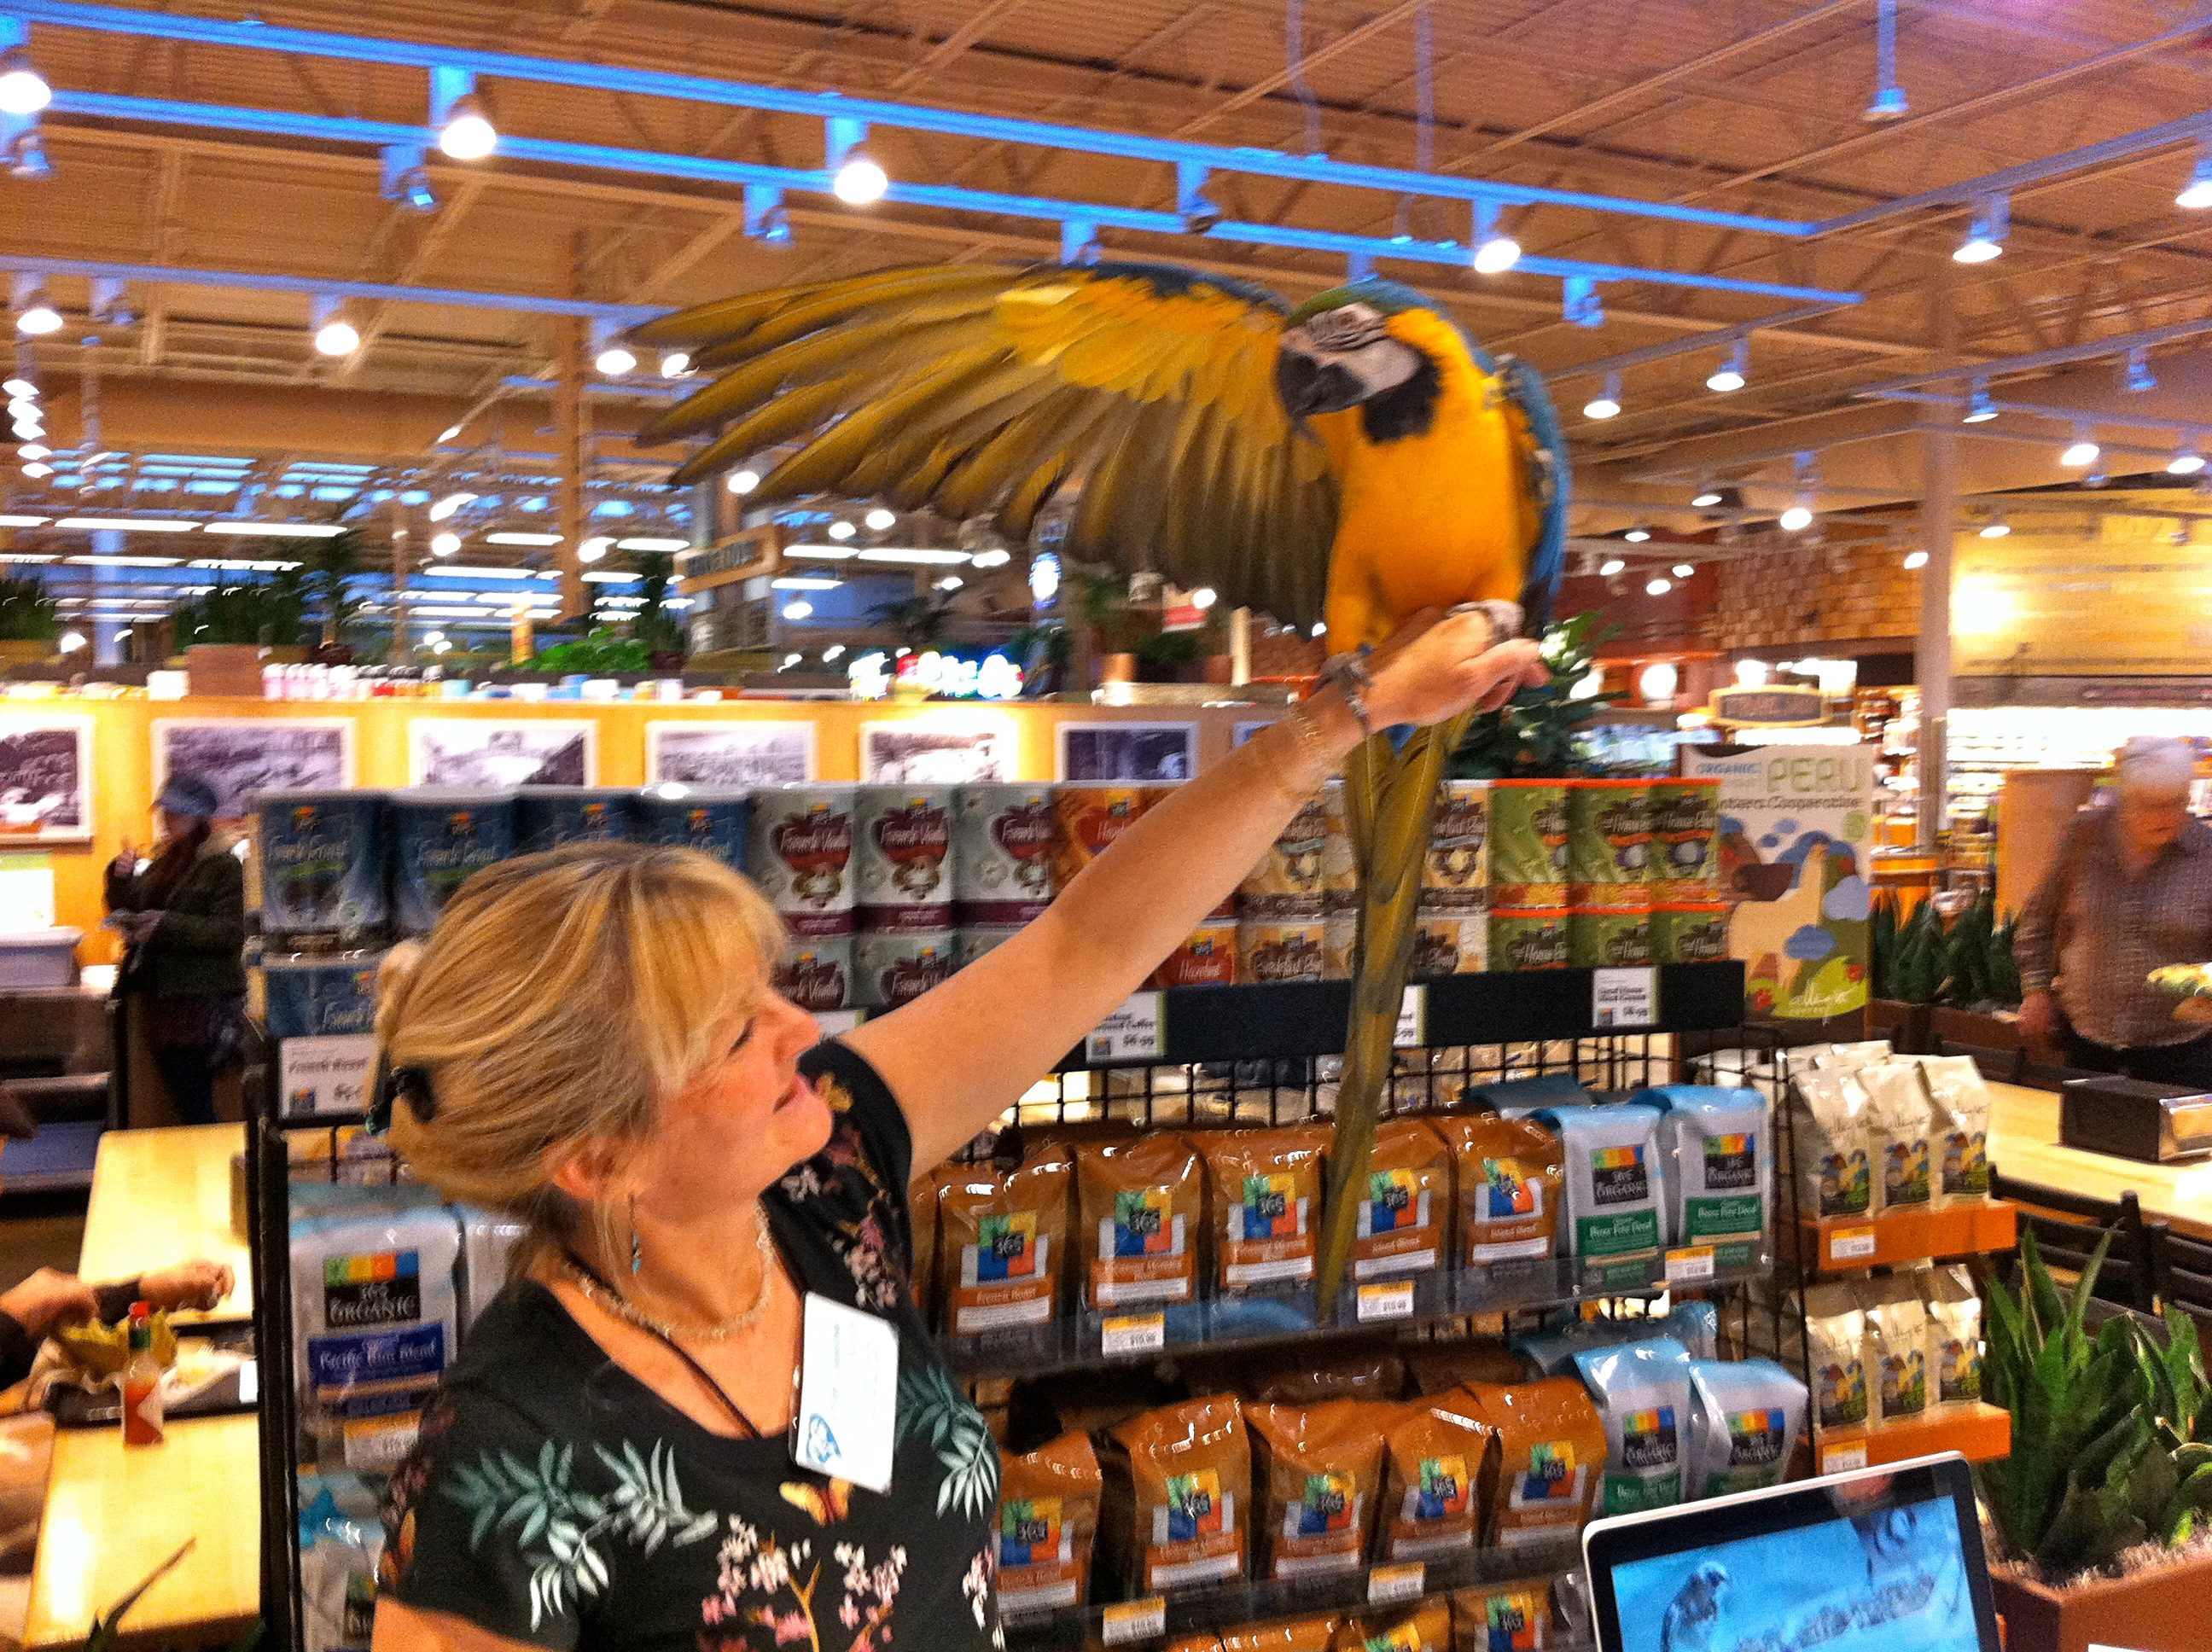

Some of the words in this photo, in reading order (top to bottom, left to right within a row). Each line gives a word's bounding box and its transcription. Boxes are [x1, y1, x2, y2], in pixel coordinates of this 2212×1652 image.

[1767, 756, 1865, 793] PERU
[1258, 1194, 1285, 1216] 365
[1131, 1210, 1160, 1233] 365
[995, 1233, 1023, 1256] 365
[329, 1294, 416, 1322] ORGANIC
